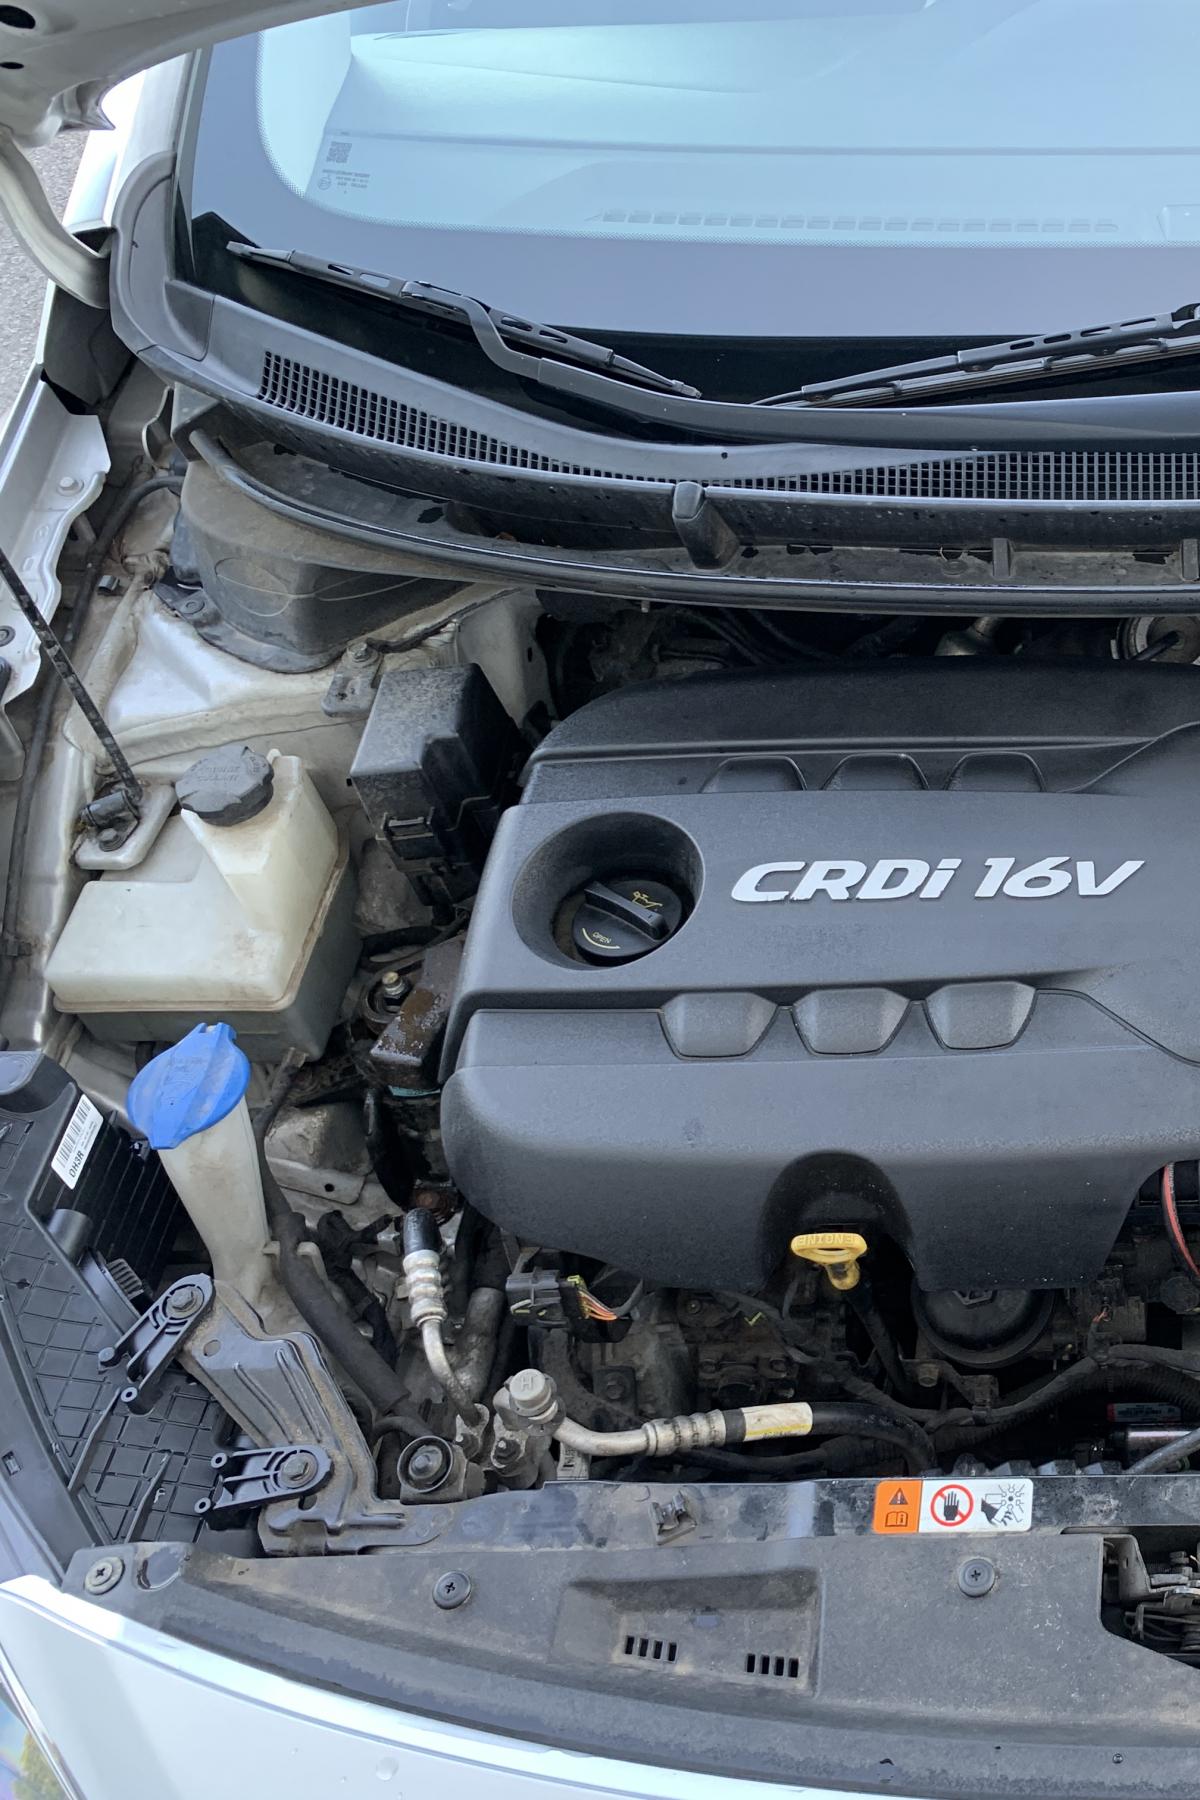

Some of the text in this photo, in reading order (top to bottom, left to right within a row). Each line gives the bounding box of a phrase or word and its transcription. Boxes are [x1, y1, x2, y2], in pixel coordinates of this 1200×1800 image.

[731, 856, 1145, 902] CRDi 16V
[592, 931, 612, 944] OPEN
